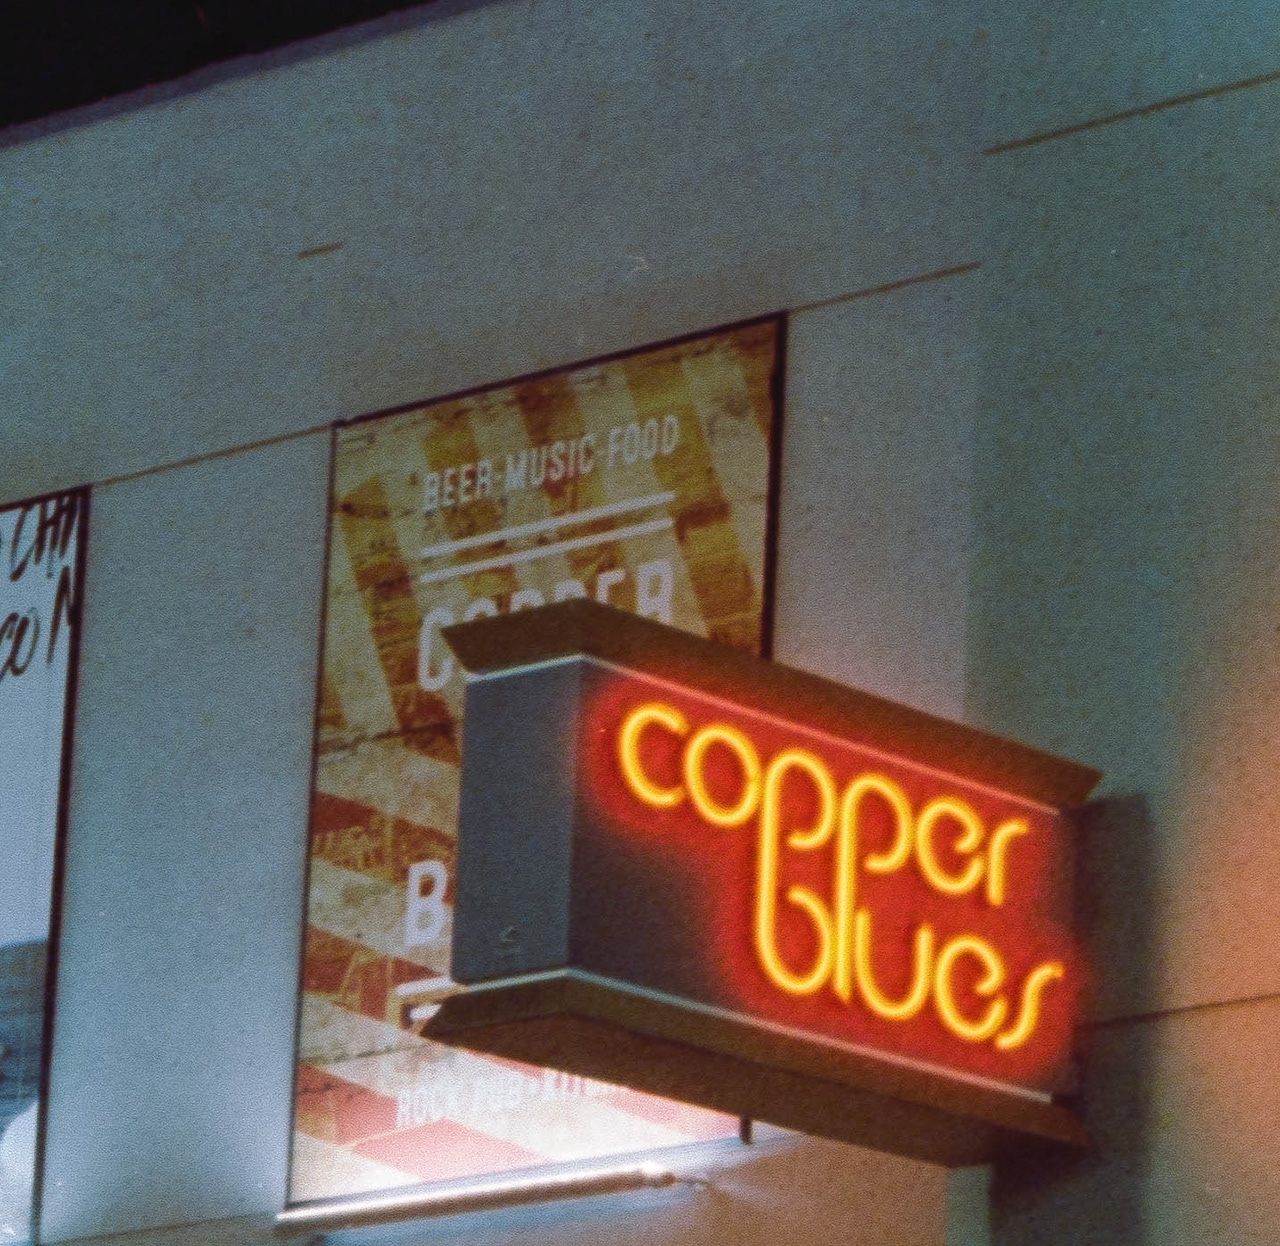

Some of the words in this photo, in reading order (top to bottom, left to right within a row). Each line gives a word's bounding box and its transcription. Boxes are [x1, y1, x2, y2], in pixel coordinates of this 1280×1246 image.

[422, 460, 493, 513] BEER
[504, 433, 596, 491] MUSIC
[606, 414, 680, 469] FOOD
[618, 699, 1031, 915] copper
[755, 880, 1066, 1053] blues
